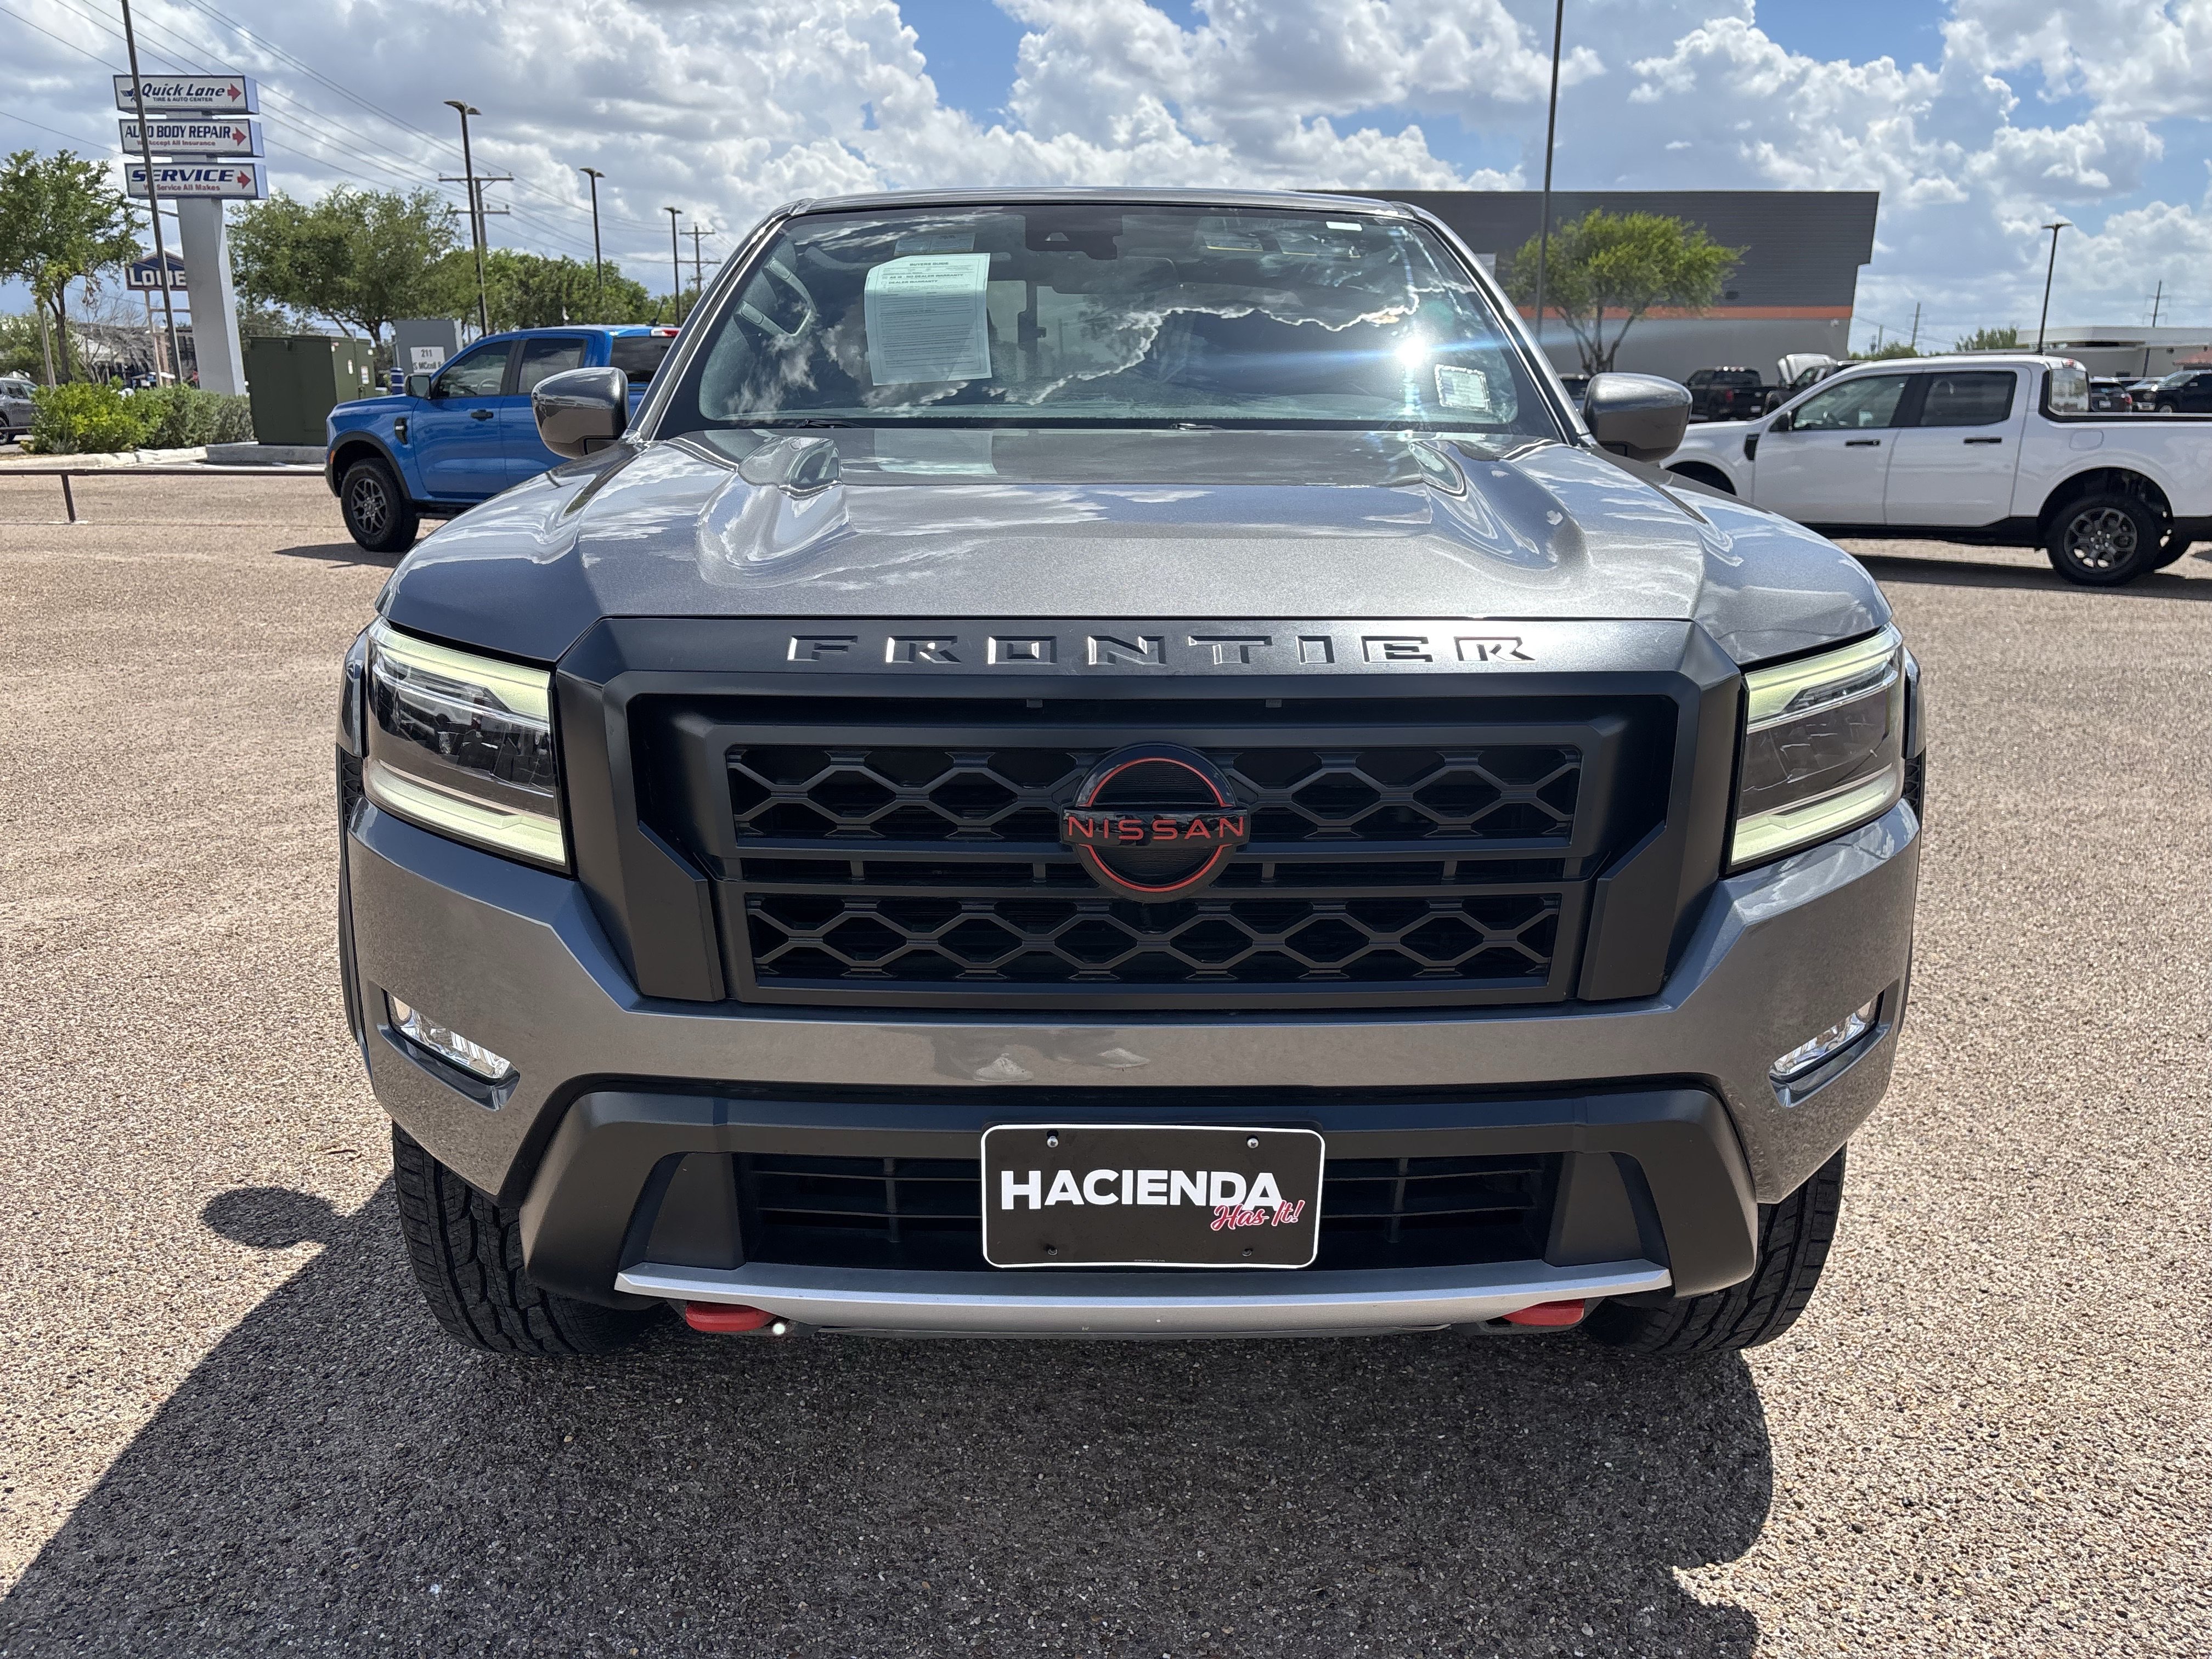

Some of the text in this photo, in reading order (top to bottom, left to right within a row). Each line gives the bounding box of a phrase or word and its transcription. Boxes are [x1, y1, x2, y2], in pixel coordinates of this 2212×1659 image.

[142, 83, 225, 97] Quick Lane
[125, 126, 230, 138] AUO BODY REPAIR
[421, 349, 433, 357] 211
[787, 635, 1537, 665] FRONTIER
[1068, 815, 1244, 840] NISSAN
[1001, 1169, 1285, 1211] HACIENDA
[1210, 1199, 1306, 1231] Has It!
